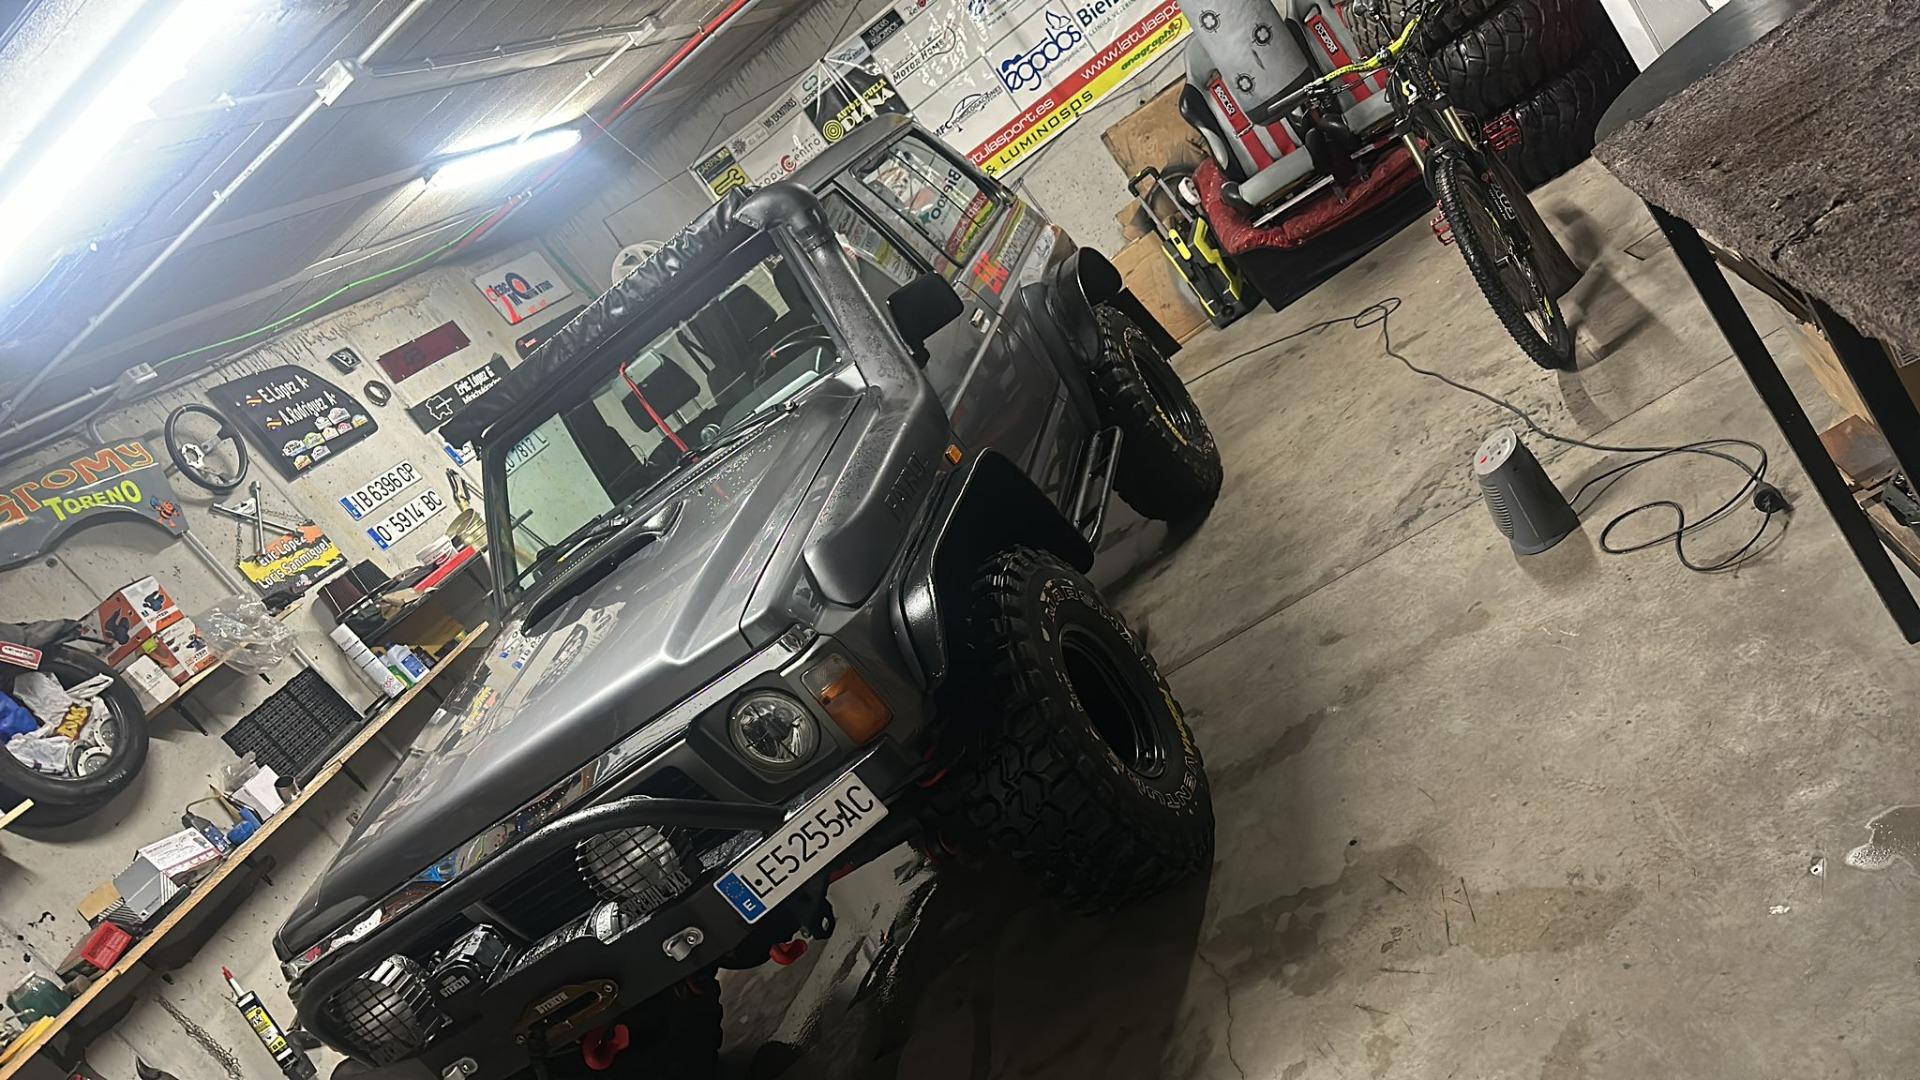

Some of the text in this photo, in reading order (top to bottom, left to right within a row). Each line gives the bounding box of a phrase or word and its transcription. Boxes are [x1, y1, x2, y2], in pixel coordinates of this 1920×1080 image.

[986, 165, 998, 176] &
[1000, 90, 1094, 165] LUMINOSOS
[256, 566, 285, 589] Loris
[282, 540, 331, 575] Sanmiguel
[743, 898, 756, 911] E
